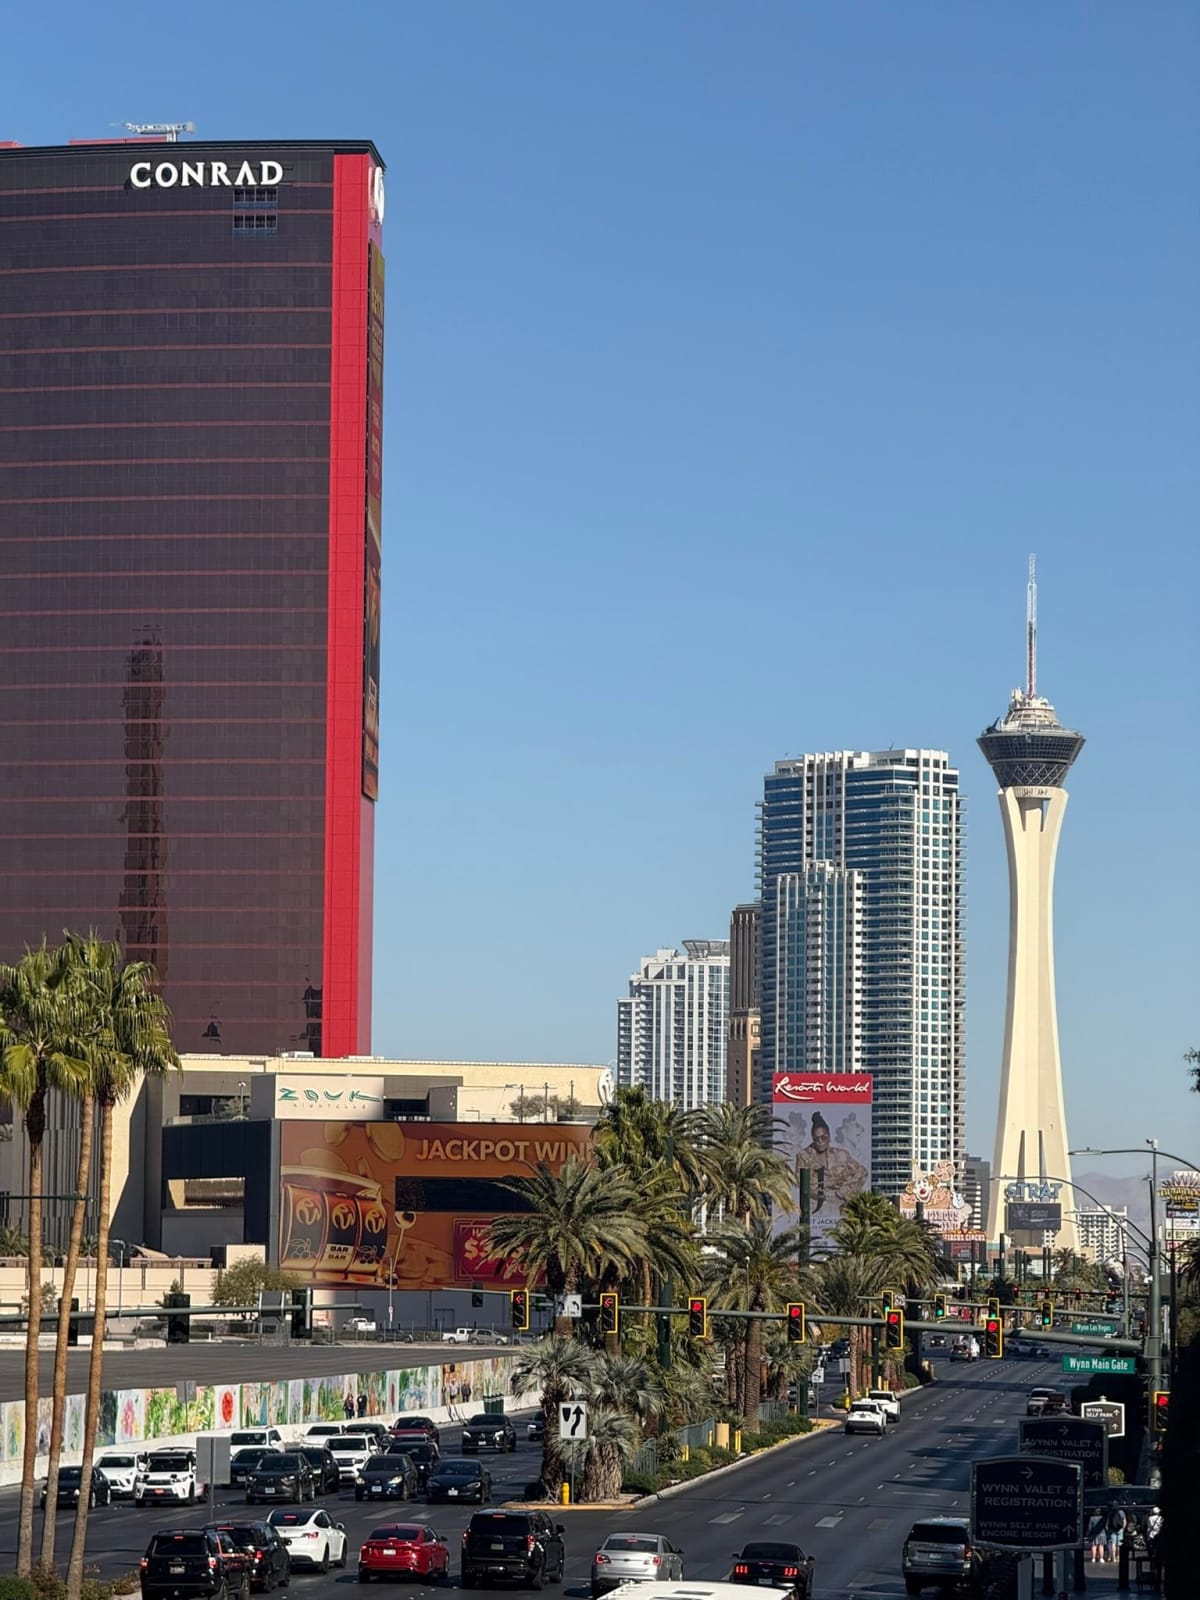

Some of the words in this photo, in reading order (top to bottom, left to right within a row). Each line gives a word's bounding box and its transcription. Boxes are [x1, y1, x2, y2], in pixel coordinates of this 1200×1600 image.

[129, 160, 284, 188] CONRAD
[826, 1081, 870, 1092] World
[416, 1140, 530, 1162] JACKPOT
[1006, 1182, 1063, 1199] STRAT
[1076, 1323, 1089, 1332] Wynn
[1069, 1357, 1090, 1371] Wynn
[1091, 1358, 1110, 1369] Main
[1111, 1359, 1128, 1370] Gate
[1060, 1439, 1091, 1448] VALET
[982, 1483, 1019, 1493] WYNN
[1024, 1484, 1063, 1494] VALET
[1066, 1486, 1075, 1495] &
[984, 1497, 1072, 1508] REGISTRATION
[979, 1520, 1007, 1528] WYNN
[1009, 1521, 1032, 1529] SELF
[1035, 1522, 1059, 1530] PARK
[981, 1529, 1018, 1537] ENCORE
[1021, 1530, 1057, 1538] RESORT
